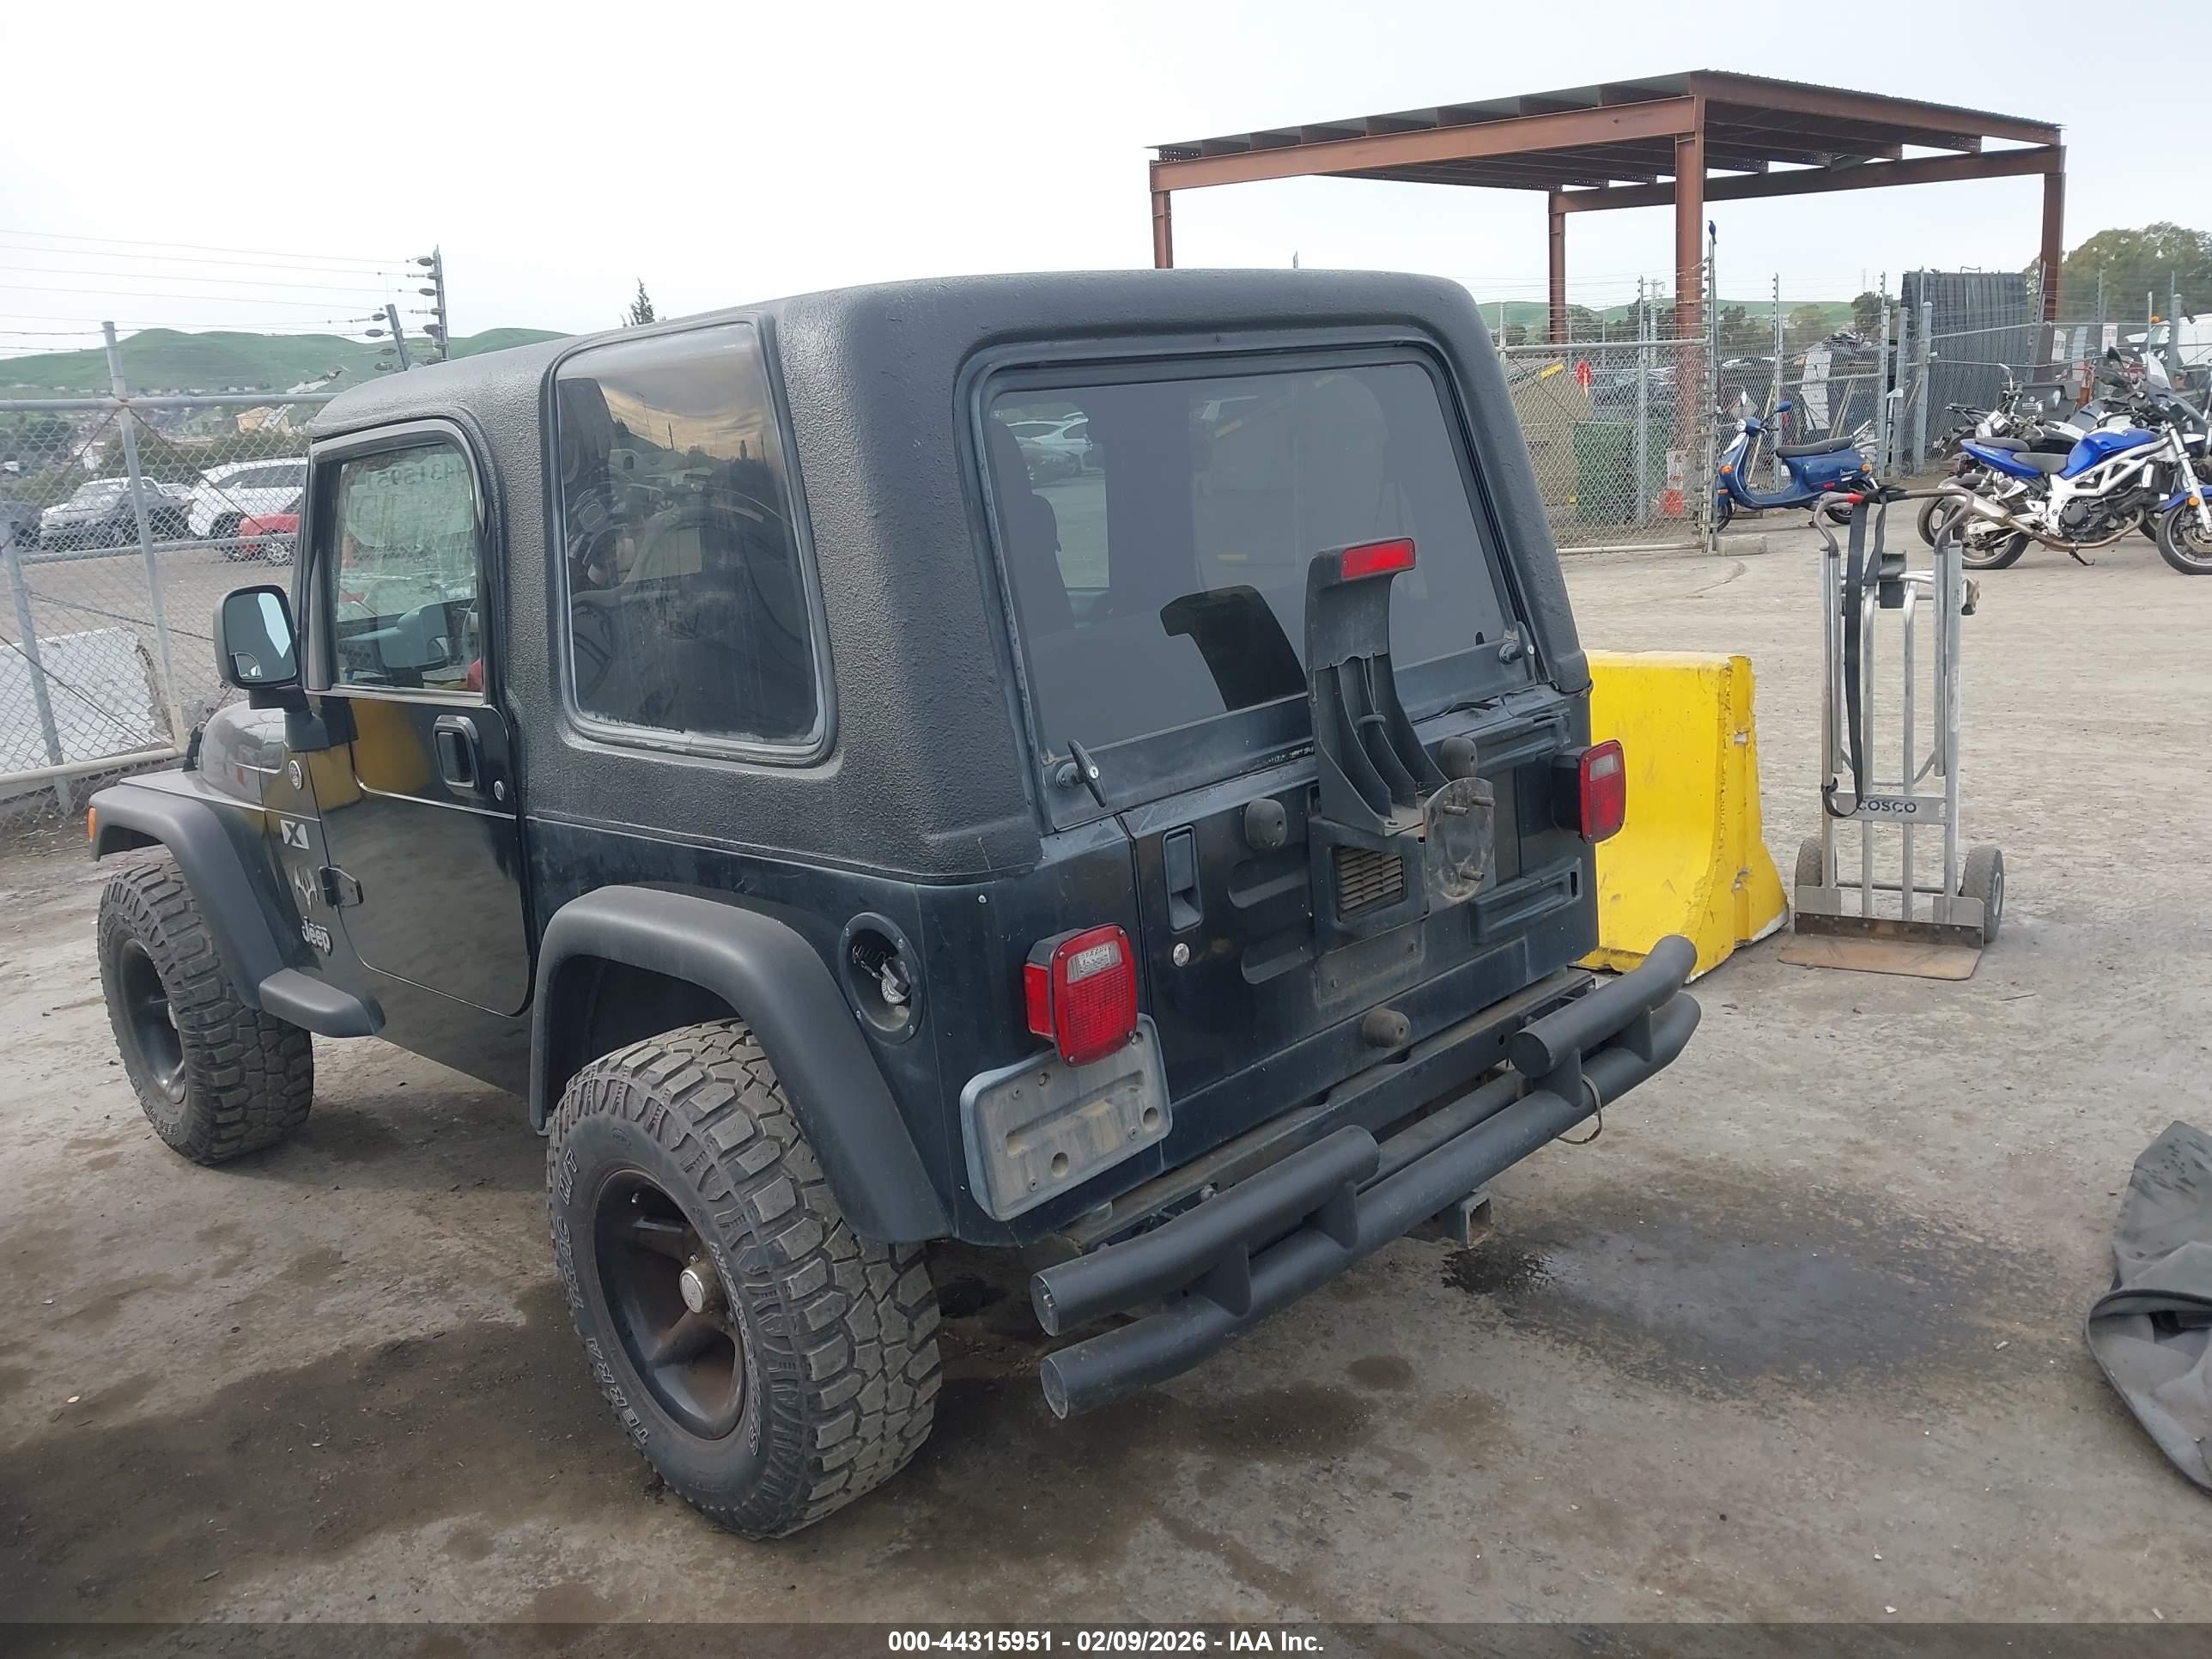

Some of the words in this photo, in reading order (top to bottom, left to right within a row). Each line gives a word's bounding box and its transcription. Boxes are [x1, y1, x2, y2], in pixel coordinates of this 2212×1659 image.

[1856, 799, 1917, 813] COSCO
[283, 820, 307, 848] X
[301, 916, 331, 956] Jeep
[557, 1148, 578, 1206] M/T
[556, 1215, 584, 1309] TRAC
[586, 1337, 648, 1444] TERRA
